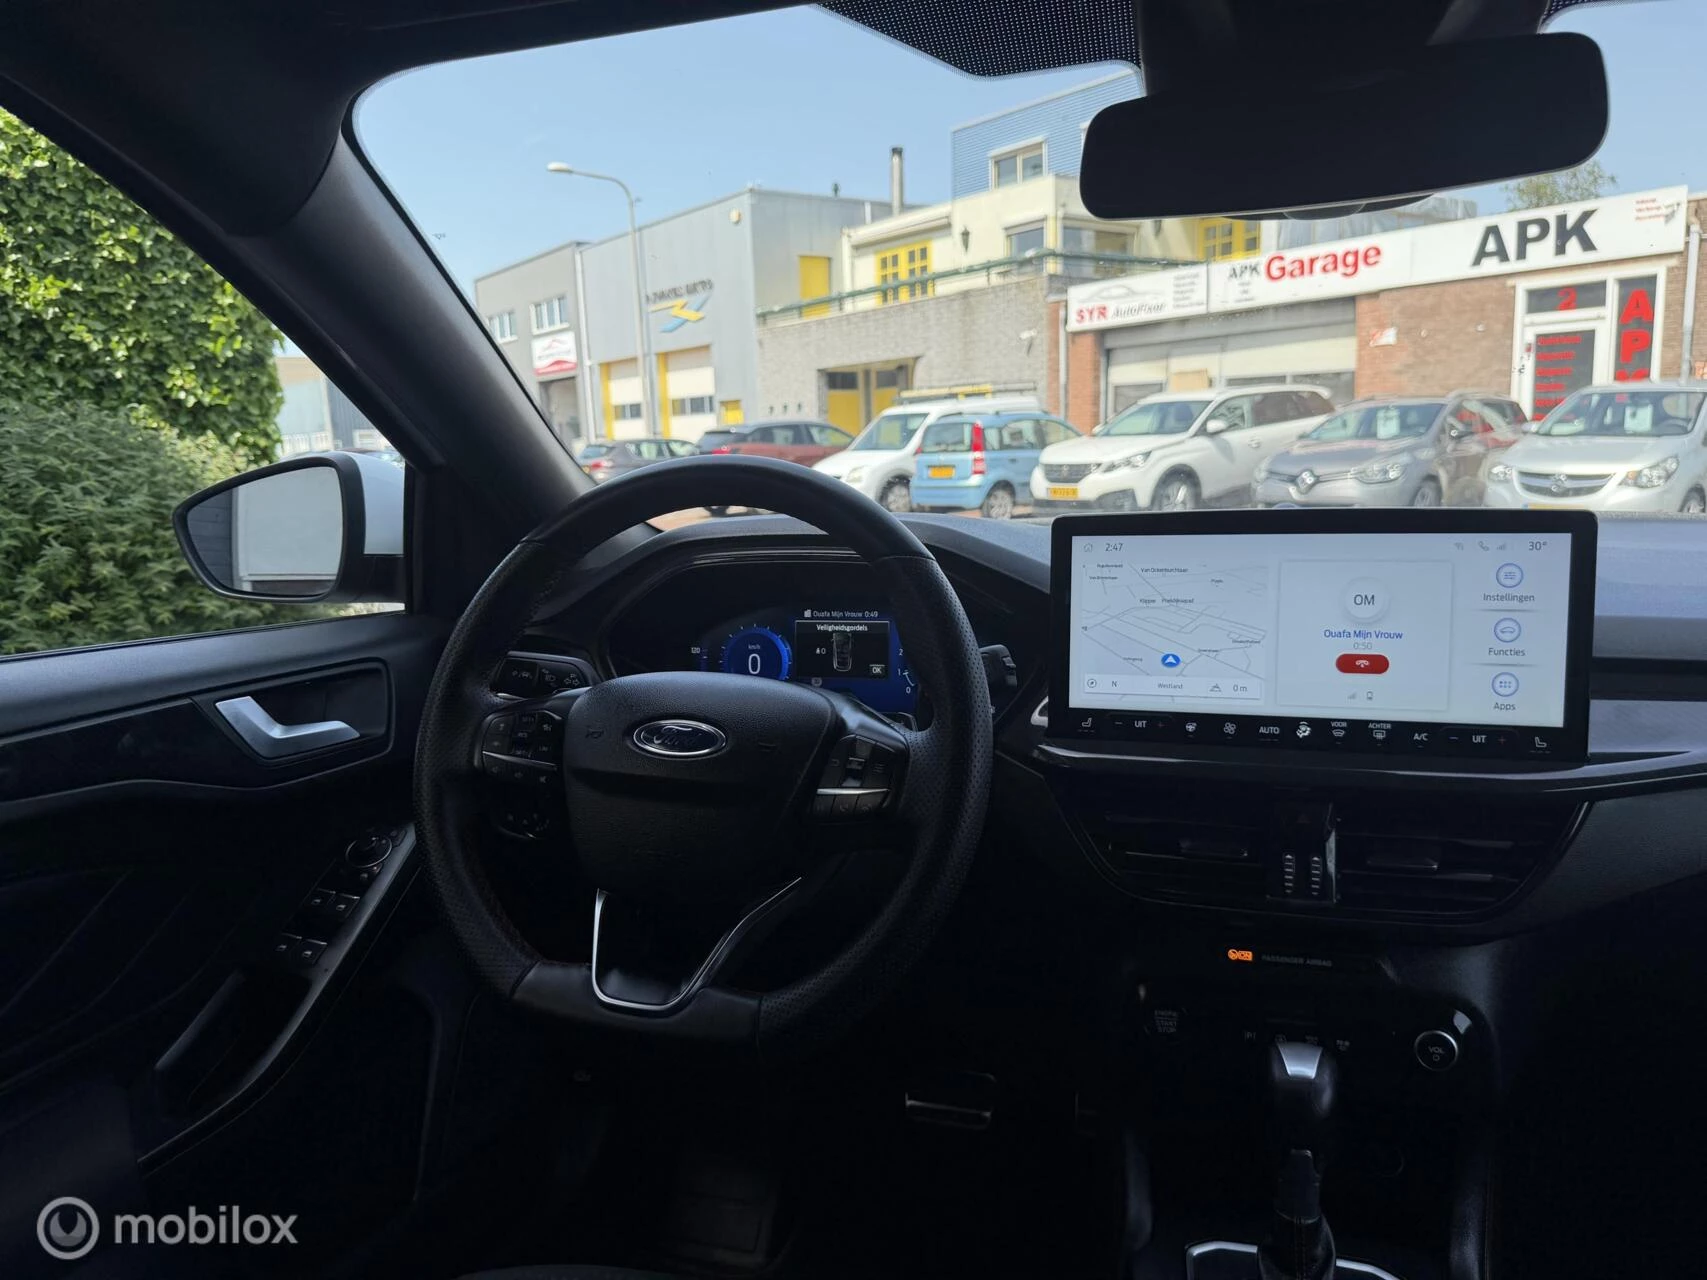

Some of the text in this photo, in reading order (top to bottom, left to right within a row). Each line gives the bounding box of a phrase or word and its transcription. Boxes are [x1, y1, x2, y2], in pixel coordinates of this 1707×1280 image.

[1470, 208, 1599, 267] APK
[1228, 245, 1381, 282] APK Garage
[1105, 543, 1124, 552] 2:47
[1528, 541, 1548, 551] 30°
[1353, 594, 1375, 606] OM
[1483, 593, 1535, 603] Instellingen
[844, 610, 863, 618] Vrouw
[1323, 629, 1403, 640] Ouafa Mijn Vrouw
[1353, 642, 1372, 650] 0:50
[1488, 647, 1526, 657] Functies
[748, 653, 761, 675] 0
[1111, 680, 1118, 688] N
[1157, 682, 1183, 690] Westland
[1493, 701, 1516, 711] Apps
[1134, 720, 1147, 729] UIT
[1368, 722, 1392, 730] ACHTER
[1259, 726, 1280, 735] AUTO
[1413, 732, 1428, 742] A/C
[1472, 735, 1487, 744] UIT
